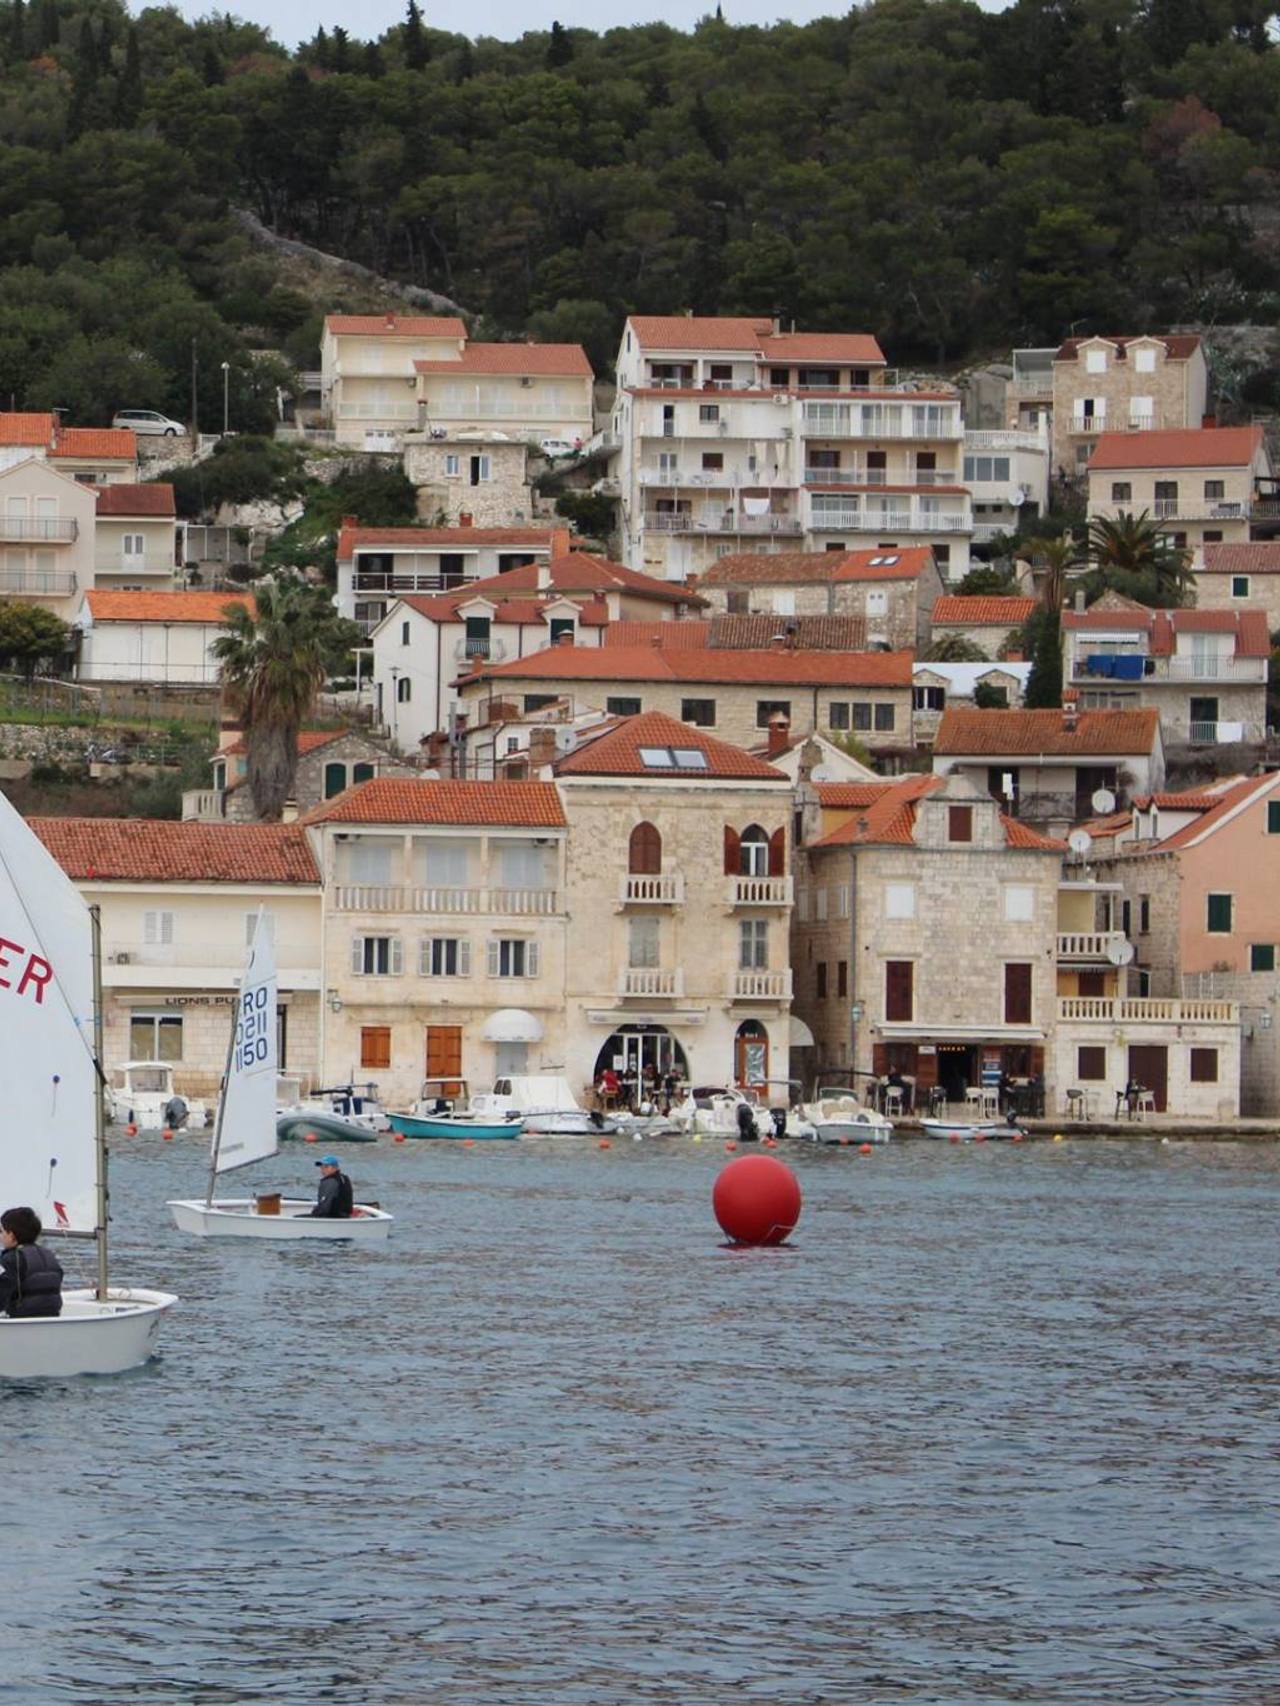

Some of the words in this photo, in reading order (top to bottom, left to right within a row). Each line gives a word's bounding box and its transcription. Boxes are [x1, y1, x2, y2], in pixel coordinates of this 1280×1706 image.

[165, 997, 210, 1005] LIONS
[214, 996, 236, 1005] PU
[242, 986, 268, 1016] RO
[235, 1037, 268, 1073] 1150
